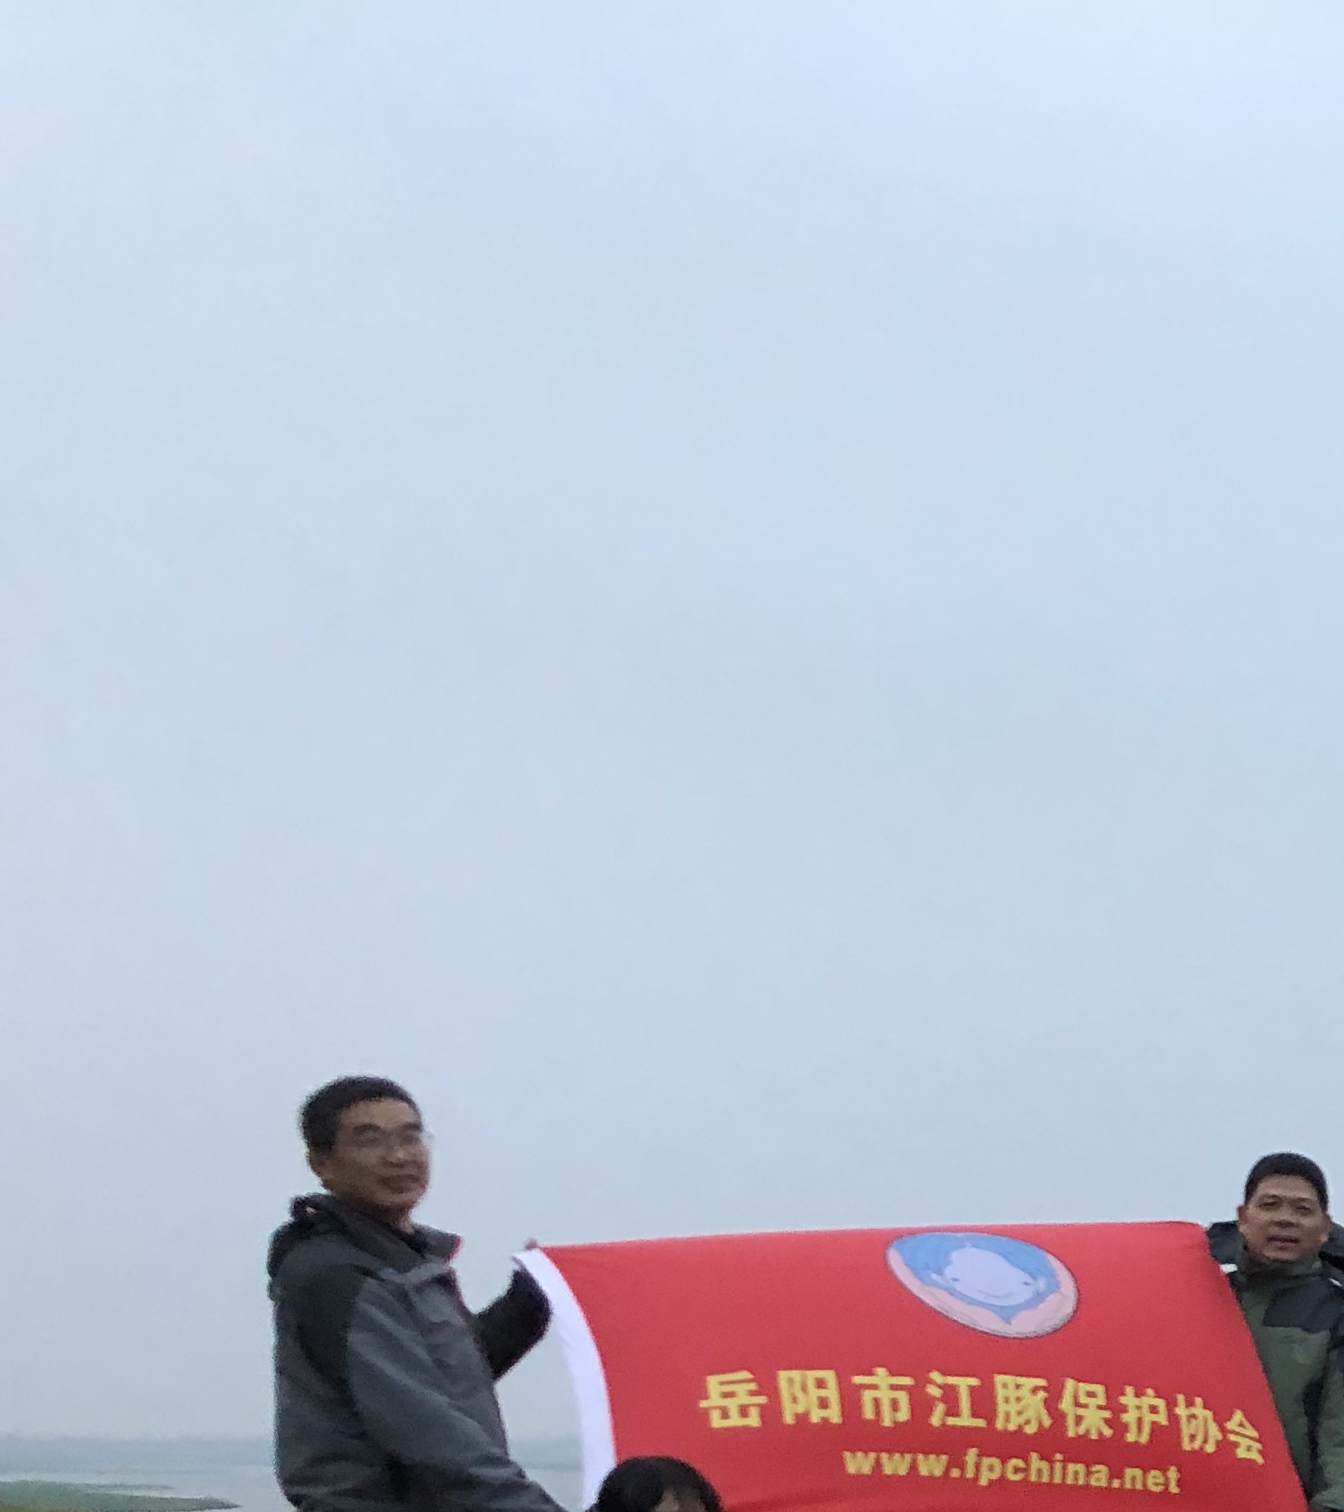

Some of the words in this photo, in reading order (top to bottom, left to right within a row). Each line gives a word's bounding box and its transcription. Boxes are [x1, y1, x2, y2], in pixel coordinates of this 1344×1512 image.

[700, 1368, 1264, 1464] 岳阳市江豚保护协会
[843, 1448, 1181, 1493] www.fpchina.net
